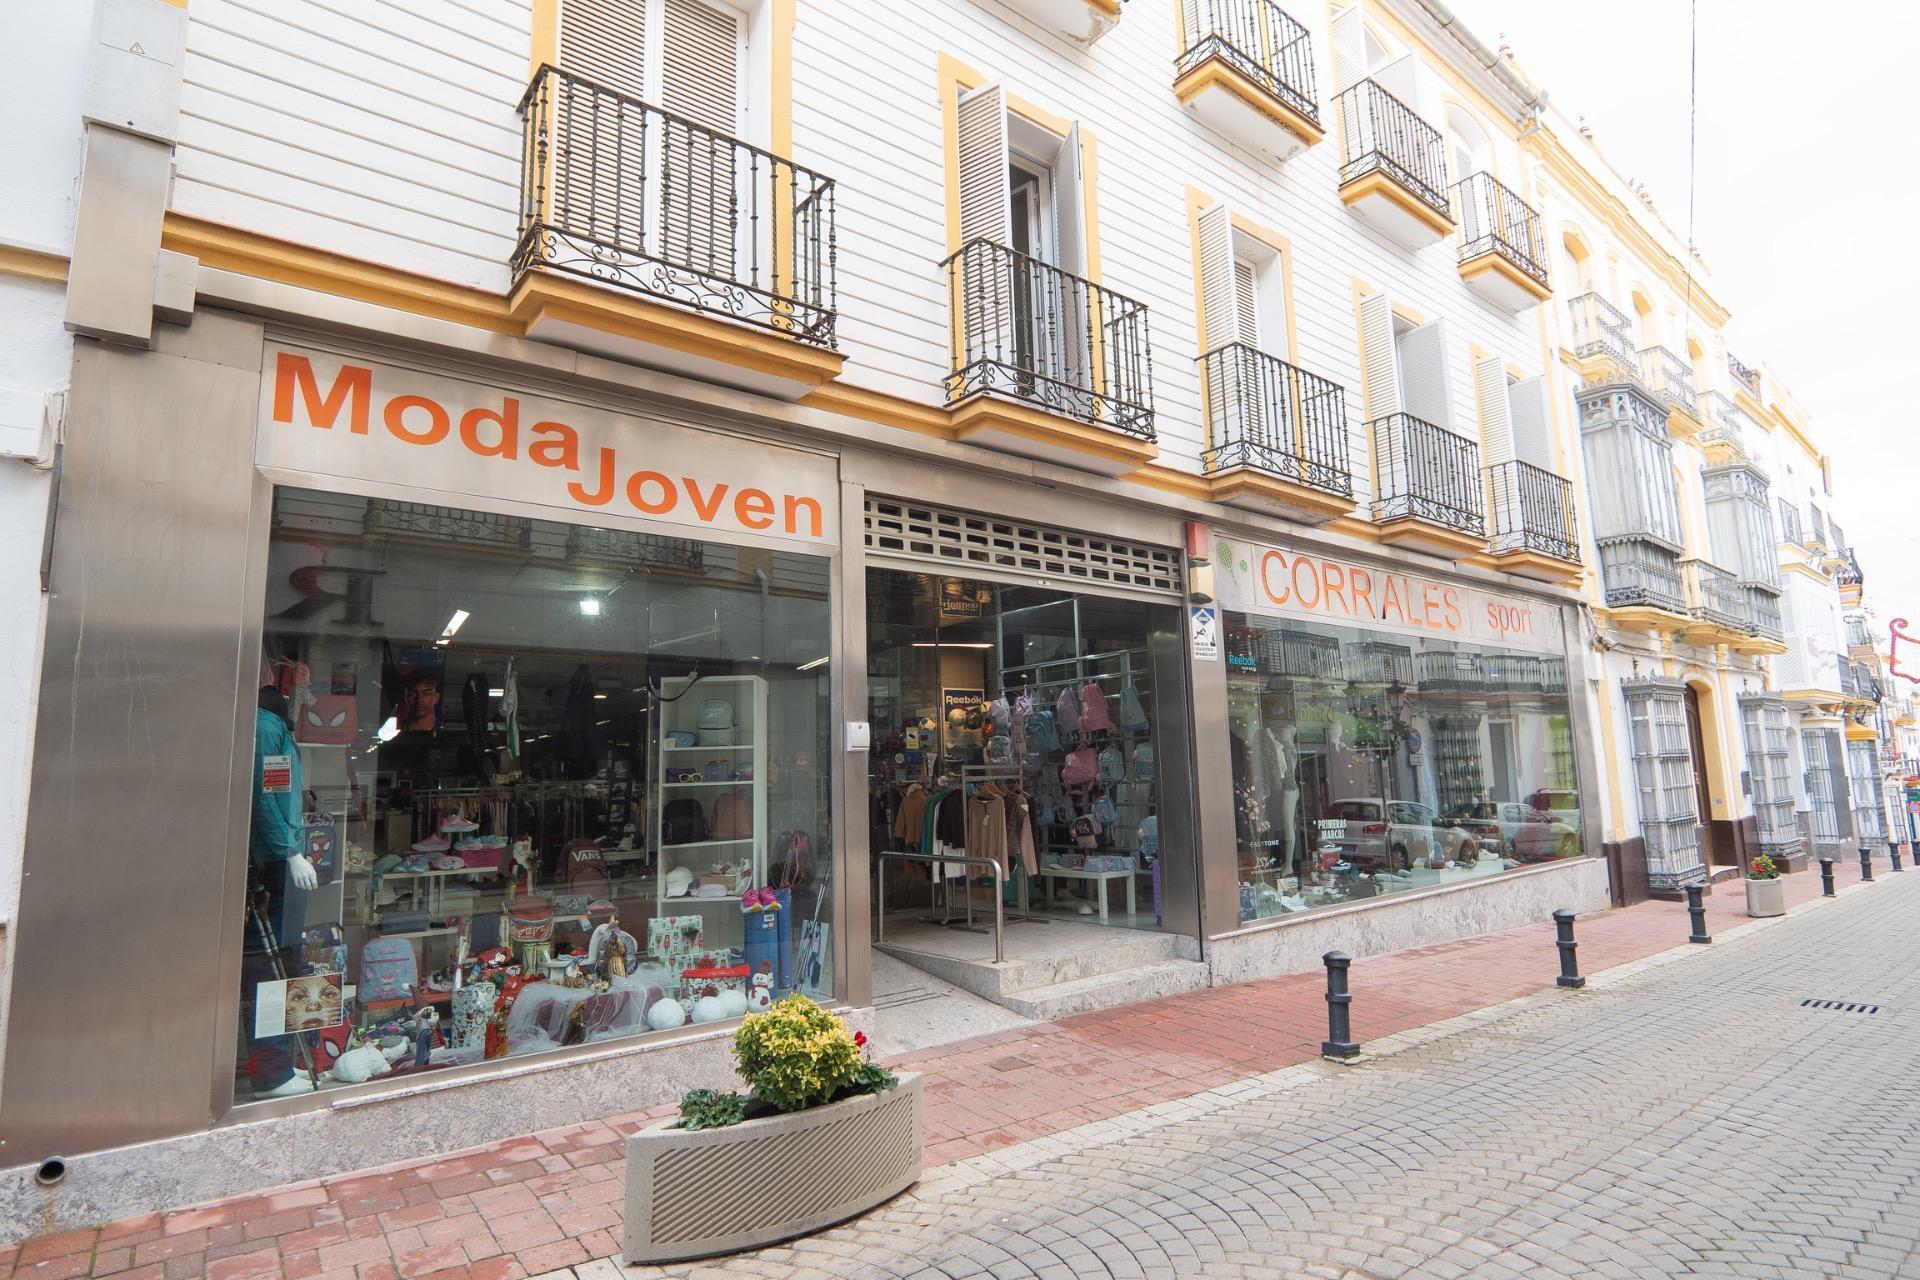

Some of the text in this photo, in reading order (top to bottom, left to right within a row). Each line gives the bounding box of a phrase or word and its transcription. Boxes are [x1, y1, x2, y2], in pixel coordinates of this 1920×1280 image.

[272, 352, 822, 538] Moda Joven
[1261, 549, 1534, 639] CORRALES sport
[1229, 655, 1256, 667] Reebok
[945, 695, 982, 705] Reebok
[1317, 818, 1347, 830] PRIMERAS
[1321, 829, 1345, 840] MARCAS
[572, 850, 601, 862] VANS
